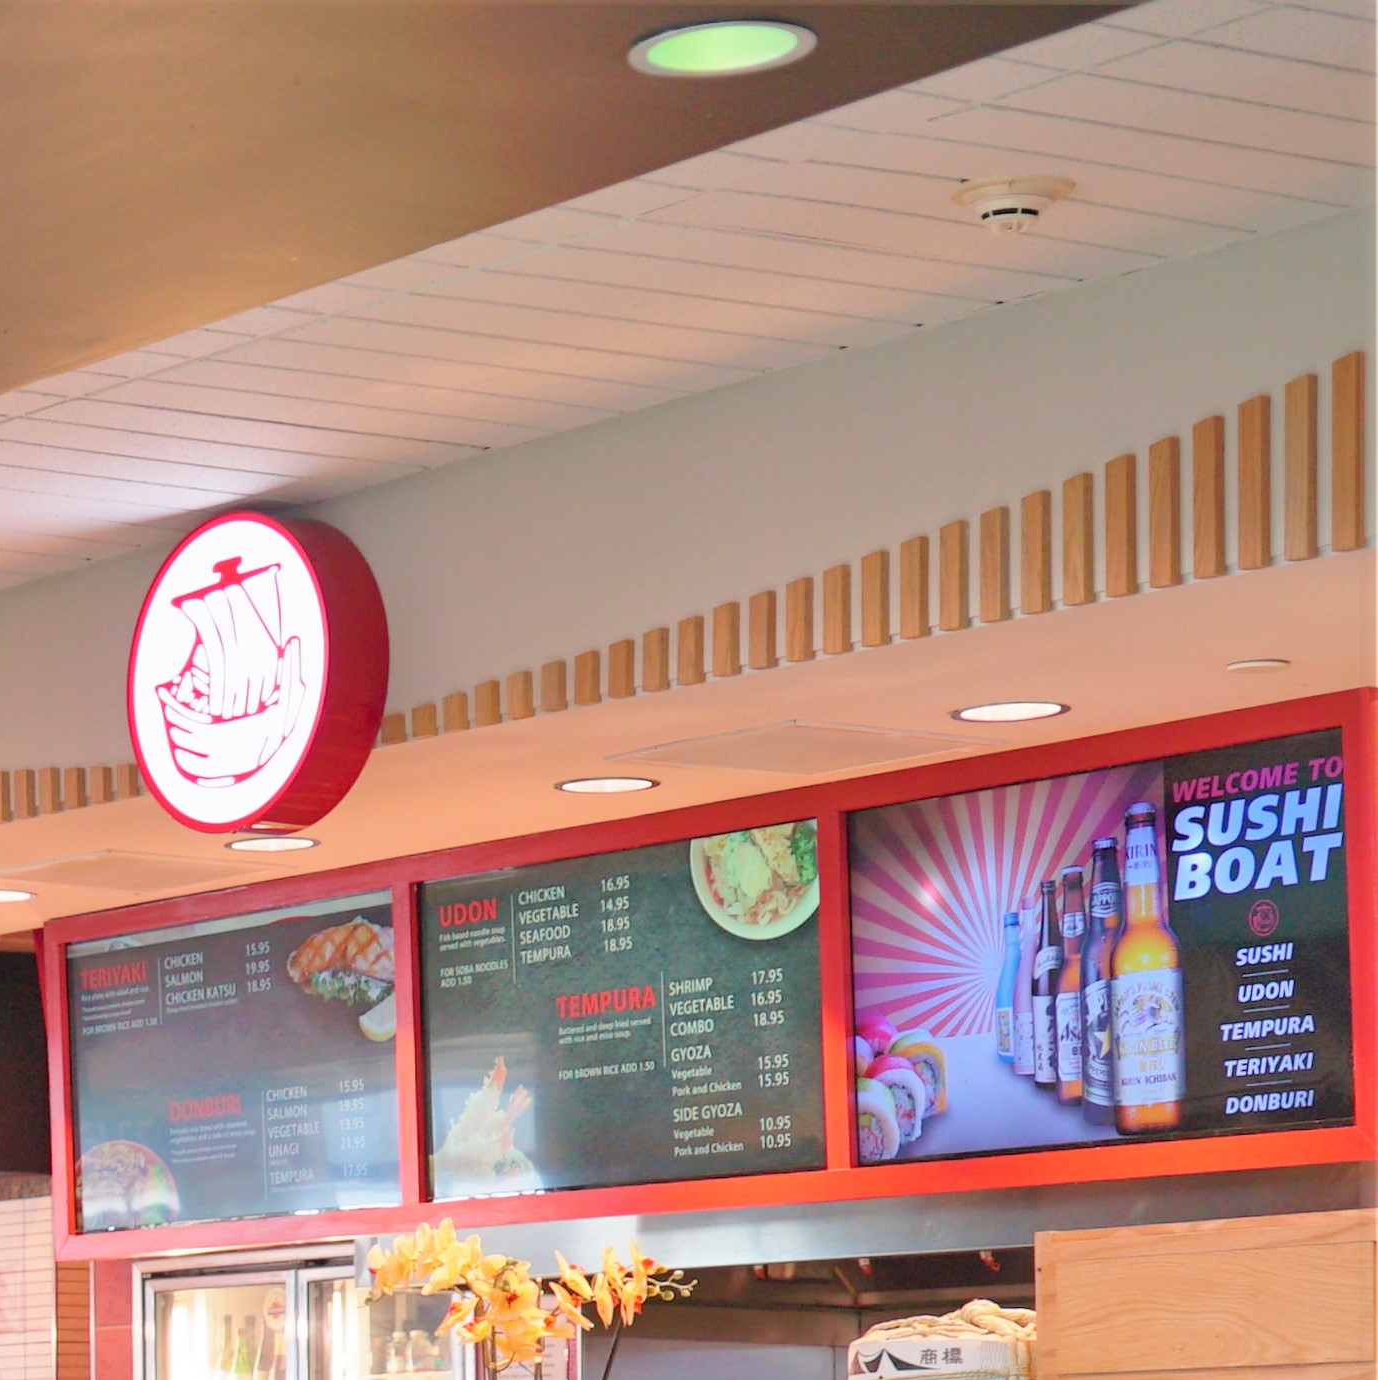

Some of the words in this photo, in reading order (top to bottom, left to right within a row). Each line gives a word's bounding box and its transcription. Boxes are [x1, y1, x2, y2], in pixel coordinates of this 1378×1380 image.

[1173, 764, 1297, 803] WELCOME
[1309, 756, 1343, 781] TO
[1172, 784, 1343, 851] SUSHI
[1174, 832, 1343, 901] BOAT
[519, 886, 565, 905] CHICKEN
[601, 876, 629, 892] 16.95
[439, 898, 497, 927] UDON
[519, 903, 579, 924] VEGETABLE
[600, 896, 629, 913] 14.95
[520, 925, 571, 945] SEAFOOD
[601, 917, 629, 933] 18.95
[165, 952, 203, 969] CHICKEN
[246, 941, 270, 956] 15.95
[521, 945, 571, 964] TEMPURA
[604, 937, 632, 953] 18.95
[1236, 943, 1293, 966] SUSHI
[80, 961, 146, 990] TERIYAKI
[165, 970, 203, 988] SALMON
[245, 960, 270, 975] 19.95
[475, 959, 508, 972] NOODLES
[166, 989, 204, 1006] CHICKEN
[206, 983, 236, 999] KATSU
[247, 978, 271, 993] 18.95
[441, 978, 456, 988] ADD
[669, 978, 713, 996] SHRIMP
[751, 969, 783, 985] 17.95
[1238, 980, 1294, 1002] UDON
[556, 986, 656, 1019] TEMPURA
[670, 995, 734, 1016] VEGETABLE
[751, 990, 782, 1006] 16.95
[670, 1019, 714, 1037] COMBO
[753, 1011, 784, 1027] 18.95
[1220, 1015, 1314, 1041] TEMPURA
[671, 1045, 711, 1062] GYOZA
[1224, 1053, 1314, 1077] TERIYAKI
[559, 1070, 573, 1080] FOR
[575, 1066, 602, 1078] BROWN
[603, 1065, 619, 1074] RICE
[621, 1063, 637, 1072] ADD
[672, 1066, 713, 1080] Vegetable
[758, 1054, 789, 1069] 15.95
[1121, 1076, 1141, 1086] KIRIN
[1145, 1073, 1177, 1084] ICHIBAN
[267, 1086, 307, 1102] CHICKEN
[340, 1079, 364, 1093] 15.95
[673, 1086, 691, 1096] Pork
[693, 1084, 707, 1094] and
[709, 1081, 741, 1092] Chicken
[758, 1072, 789, 1088] 15.95
[170, 1095, 241, 1122] DONBURI
[267, 1105, 307, 1120] SALMON
[340, 1098, 364, 1111] 19.95
[673, 1107, 699, 1122] SIDE
[702, 1103, 743, 1119] GYOZA
[1224, 1090, 1314, 1114] DONBURI
[268, 1122, 320, 1139] VEGETABLE
[674, 1126, 714, 1141] Vegetable
[760, 1116, 791, 1131] 10.95
[269, 1143, 299, 1158] UNAGI
[340, 1136, 365, 1149] 21.95
[674, 1147, 692, 1156] Pork
[695, 1145, 710, 1154] and
[711, 1142, 743, 1153] Chicken
[761, 1134, 791, 1149] 10.95
[270, 1169, 314, 1185] TEMPURA
[343, 1164, 367, 1177] 17.95
